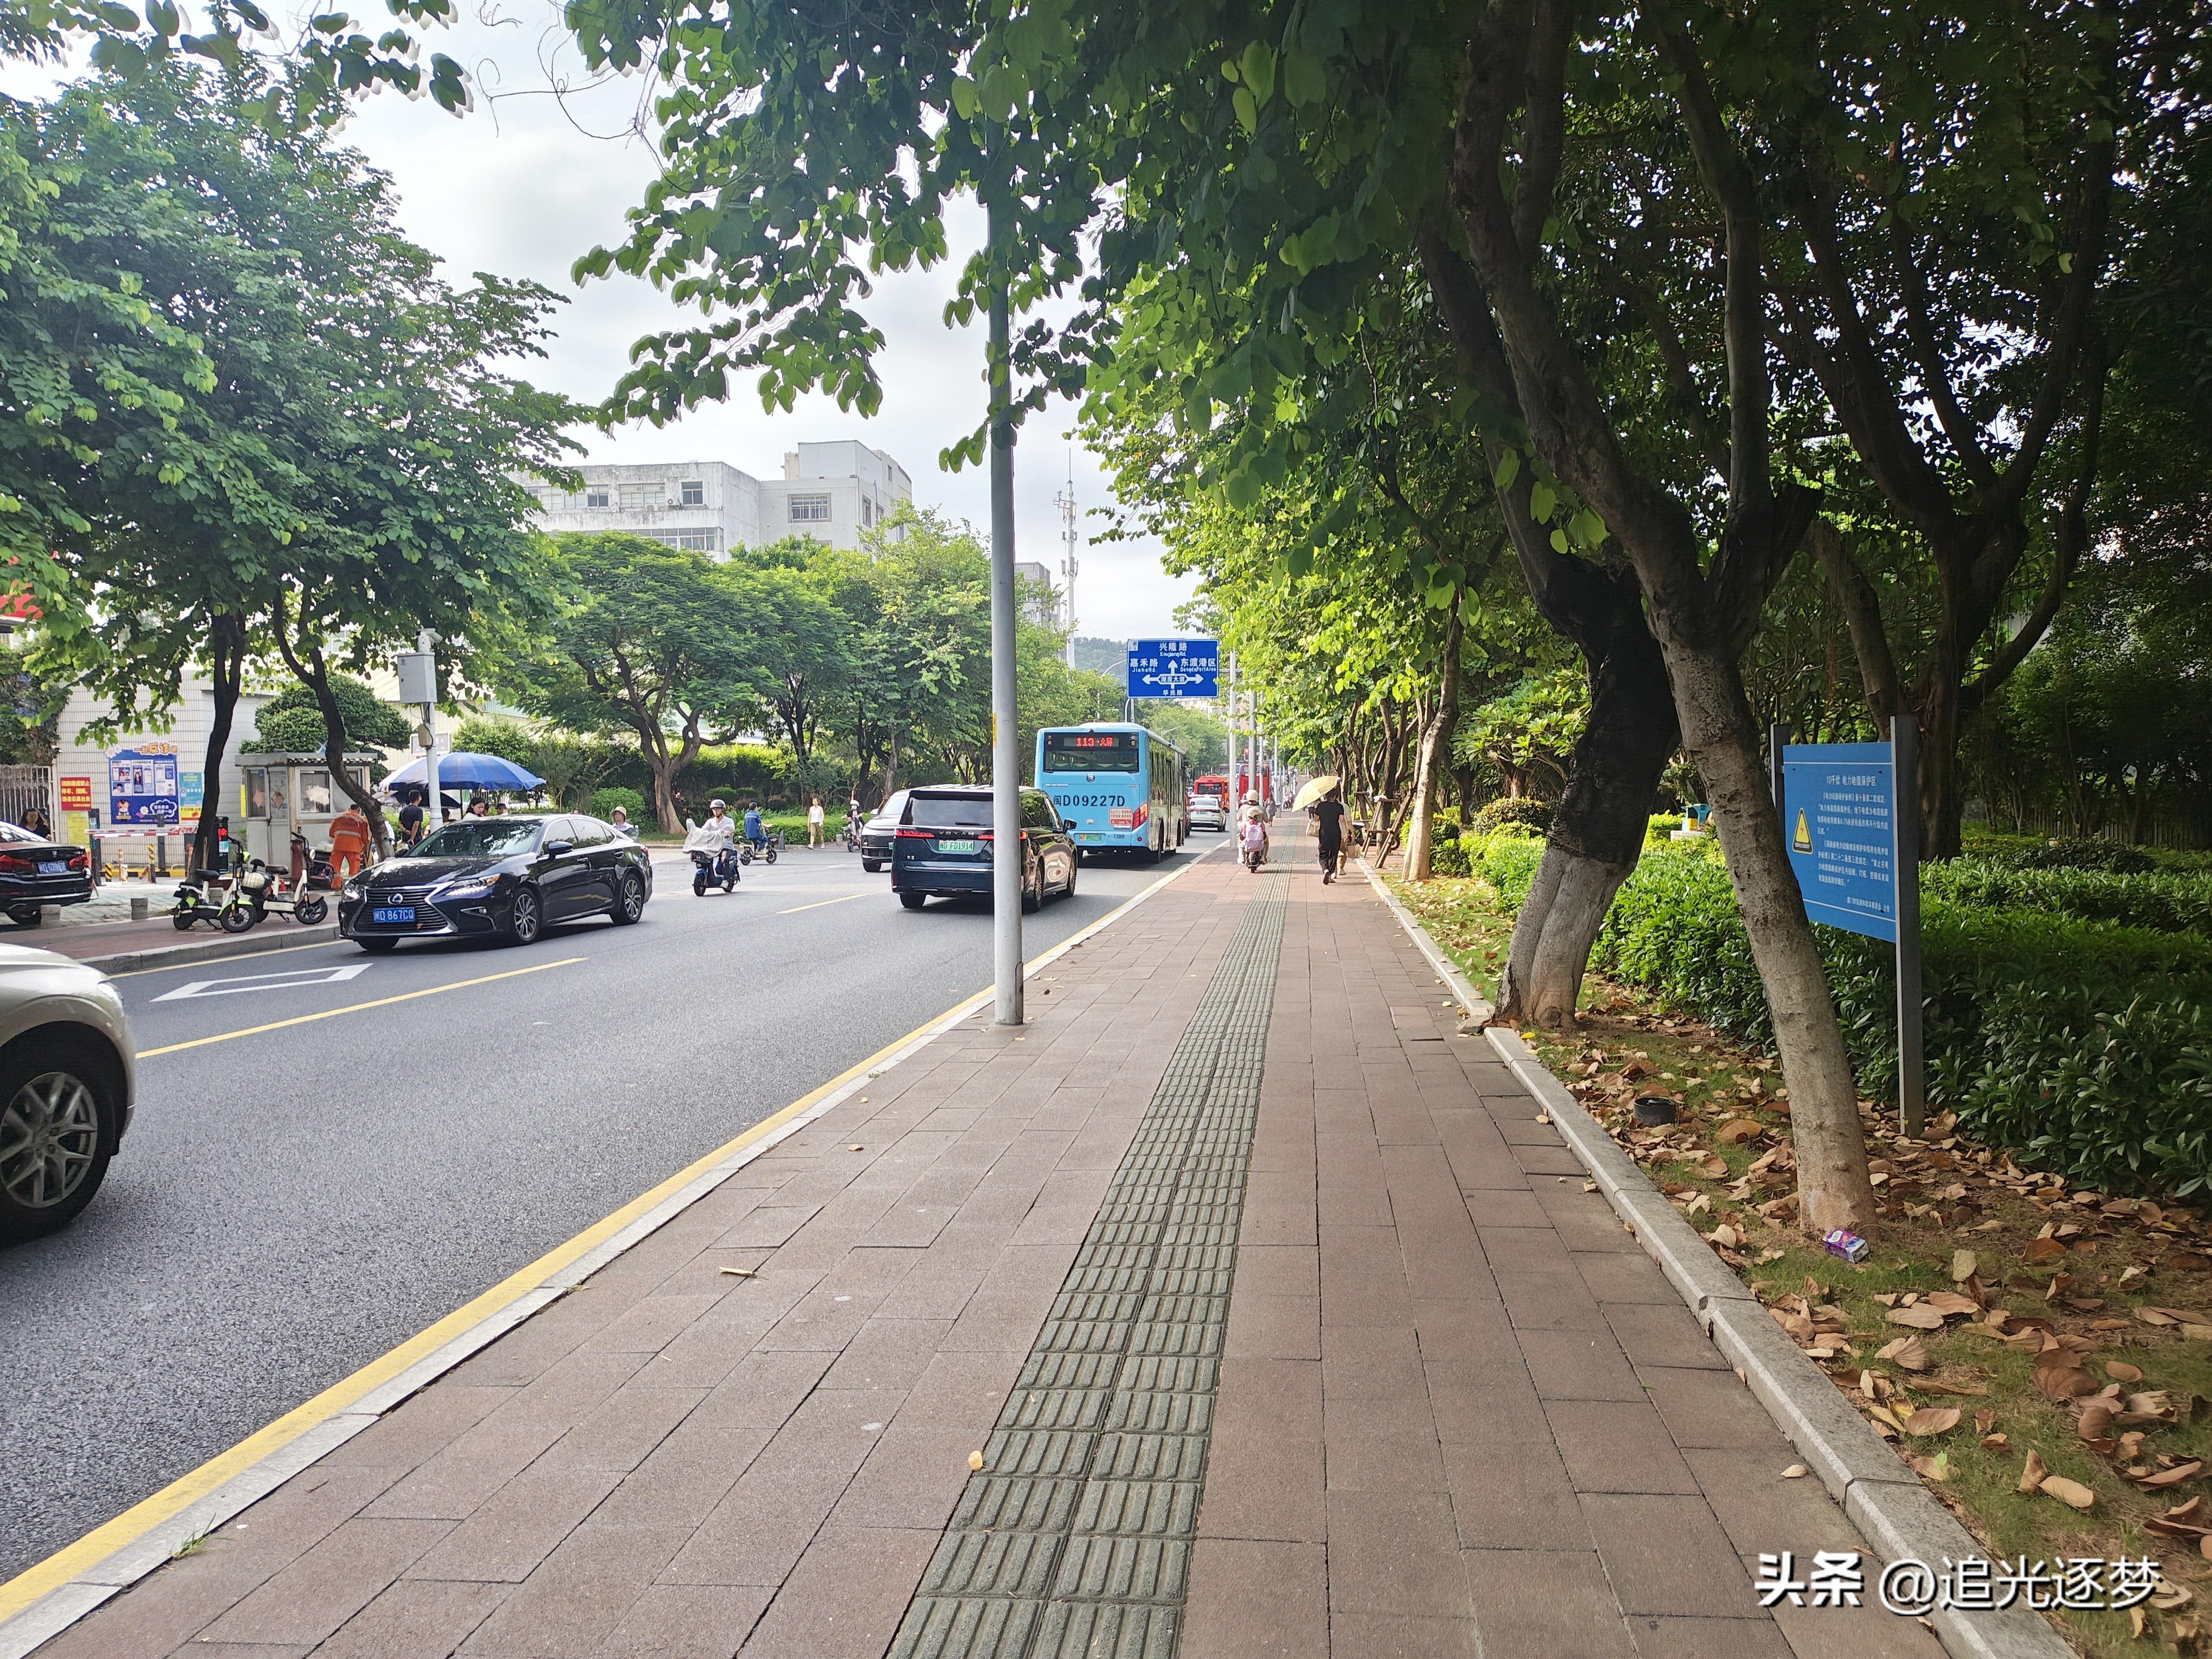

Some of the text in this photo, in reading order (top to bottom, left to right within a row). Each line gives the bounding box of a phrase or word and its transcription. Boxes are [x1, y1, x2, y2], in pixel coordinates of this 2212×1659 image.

[1159, 642, 1188, 651] 兴隆路
[1130, 658, 1158, 667] 嘉禾路
[1180, 657, 1216, 667] 东渡港区
[1053, 795, 1125, 807] 闽D09227D
